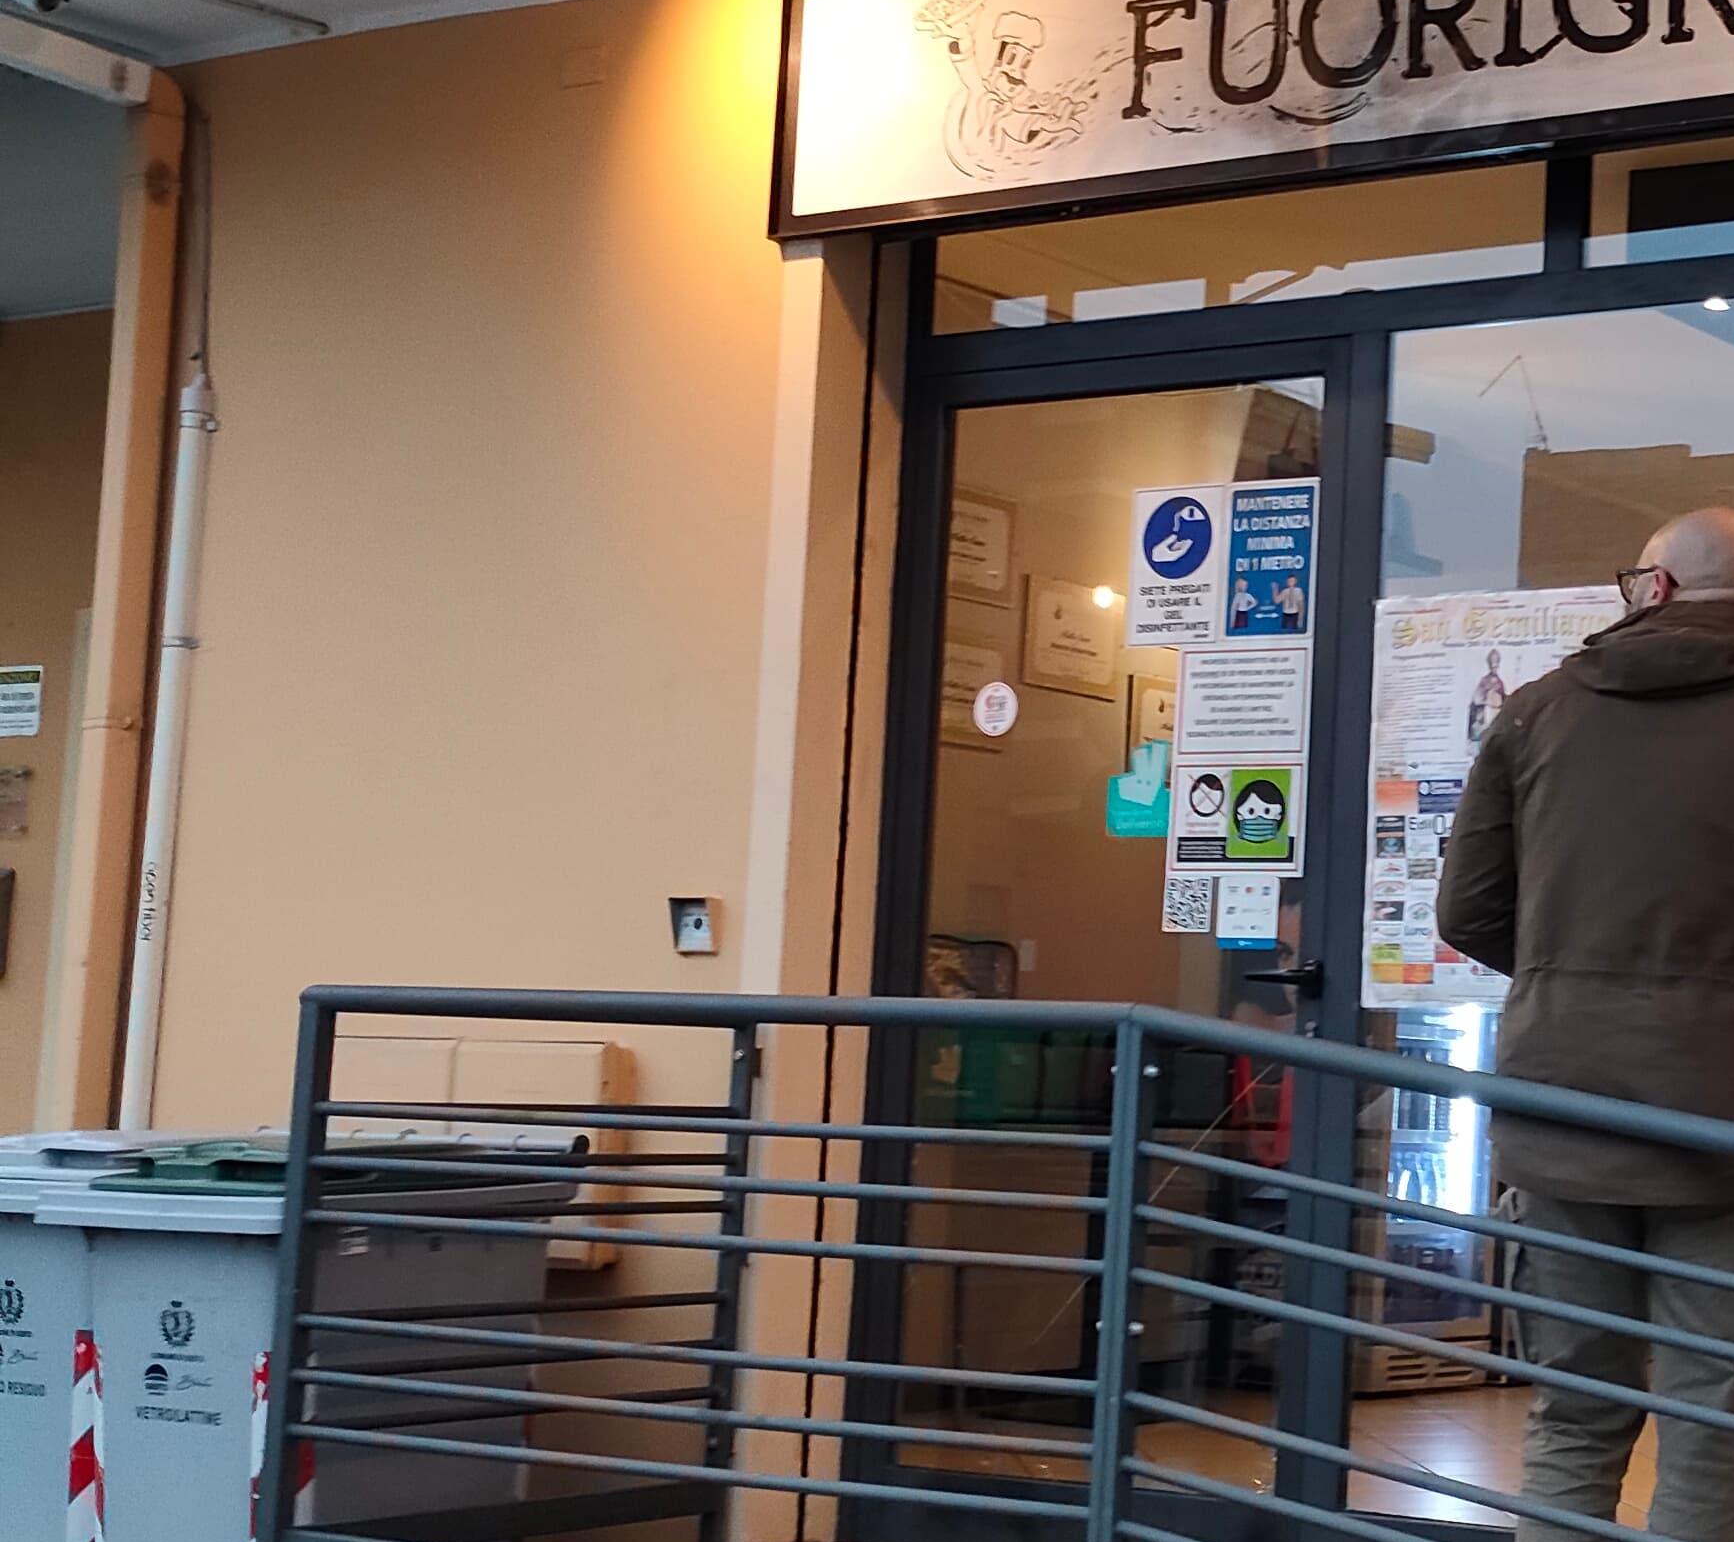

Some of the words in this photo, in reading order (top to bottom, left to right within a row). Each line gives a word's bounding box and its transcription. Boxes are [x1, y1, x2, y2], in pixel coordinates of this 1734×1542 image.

[1236, 494, 1310, 512] MANTENERE
[1233, 518, 1248, 532] LA
[1250, 514, 1311, 530] DISTANZA
[1261, 555, 1305, 571] METRO
